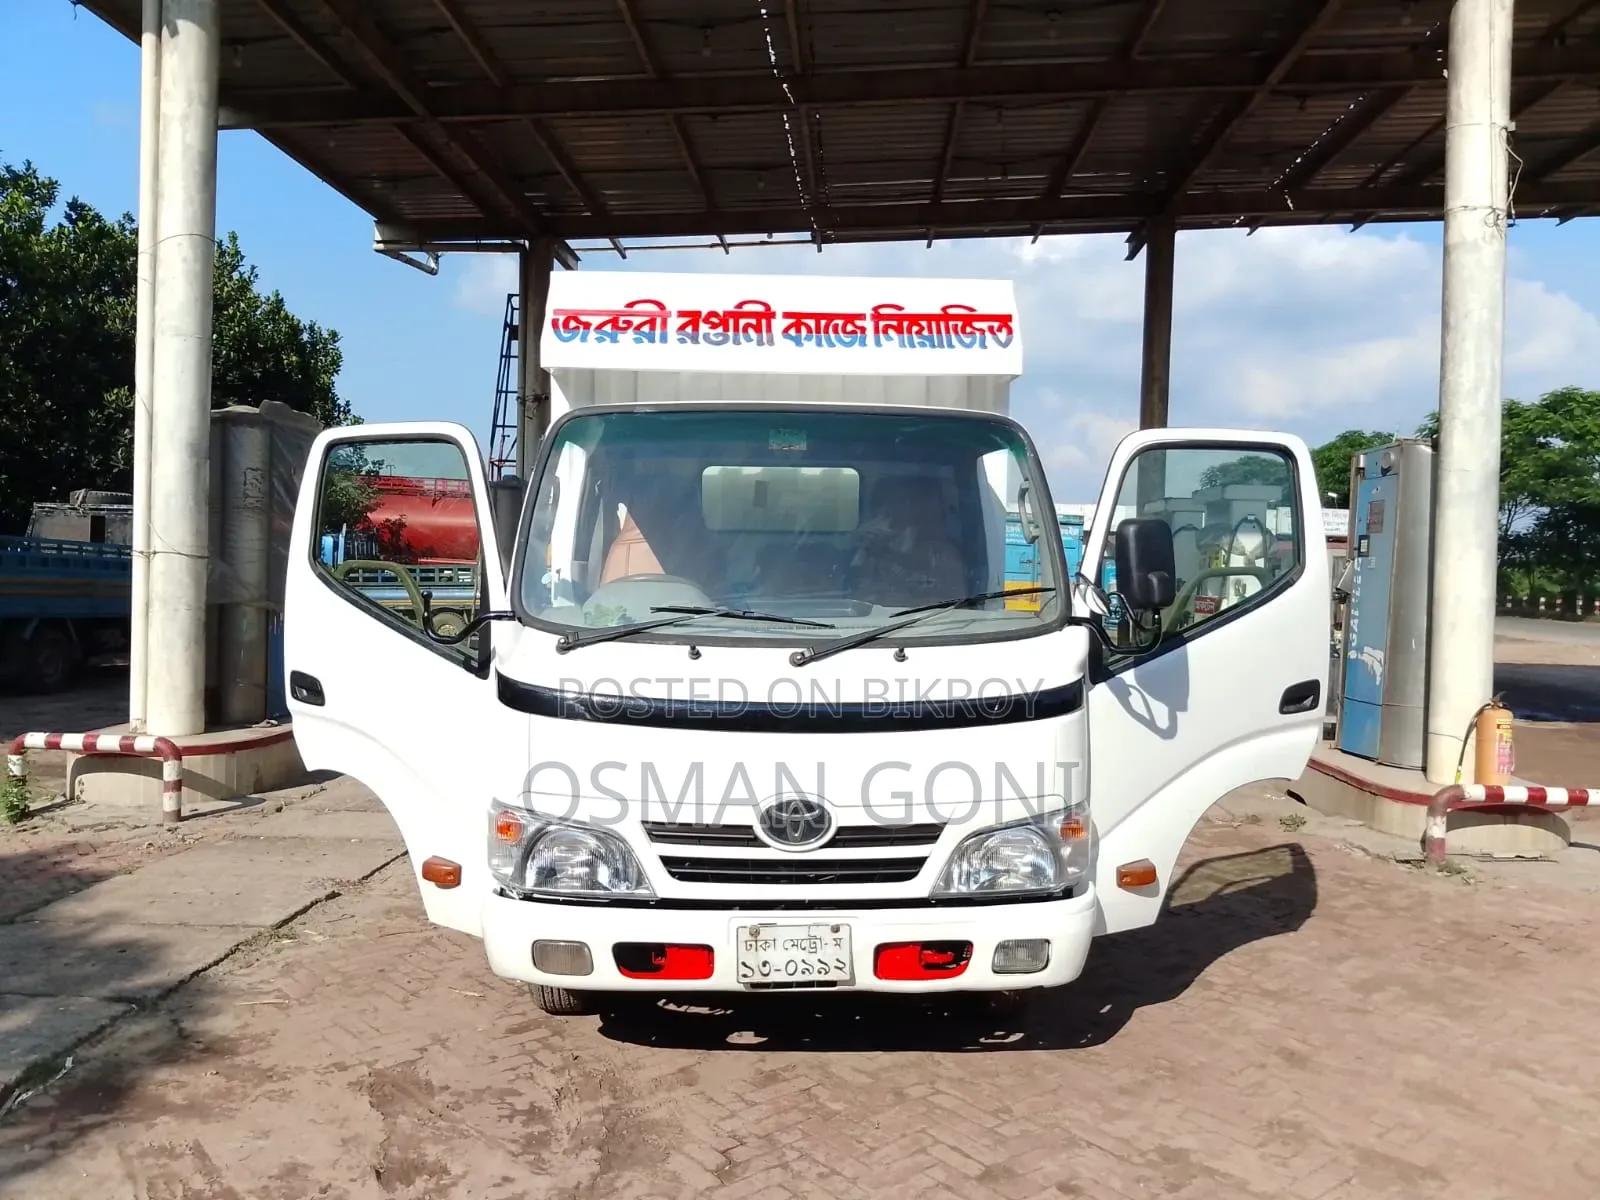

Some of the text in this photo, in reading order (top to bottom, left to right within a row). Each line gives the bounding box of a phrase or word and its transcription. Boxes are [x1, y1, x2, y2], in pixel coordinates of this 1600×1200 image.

[551, 299, 1013, 350] জরুরী রপ্তানী কাজে নিয়োজিত
[744, 937, 777, 953] ঢাকা
